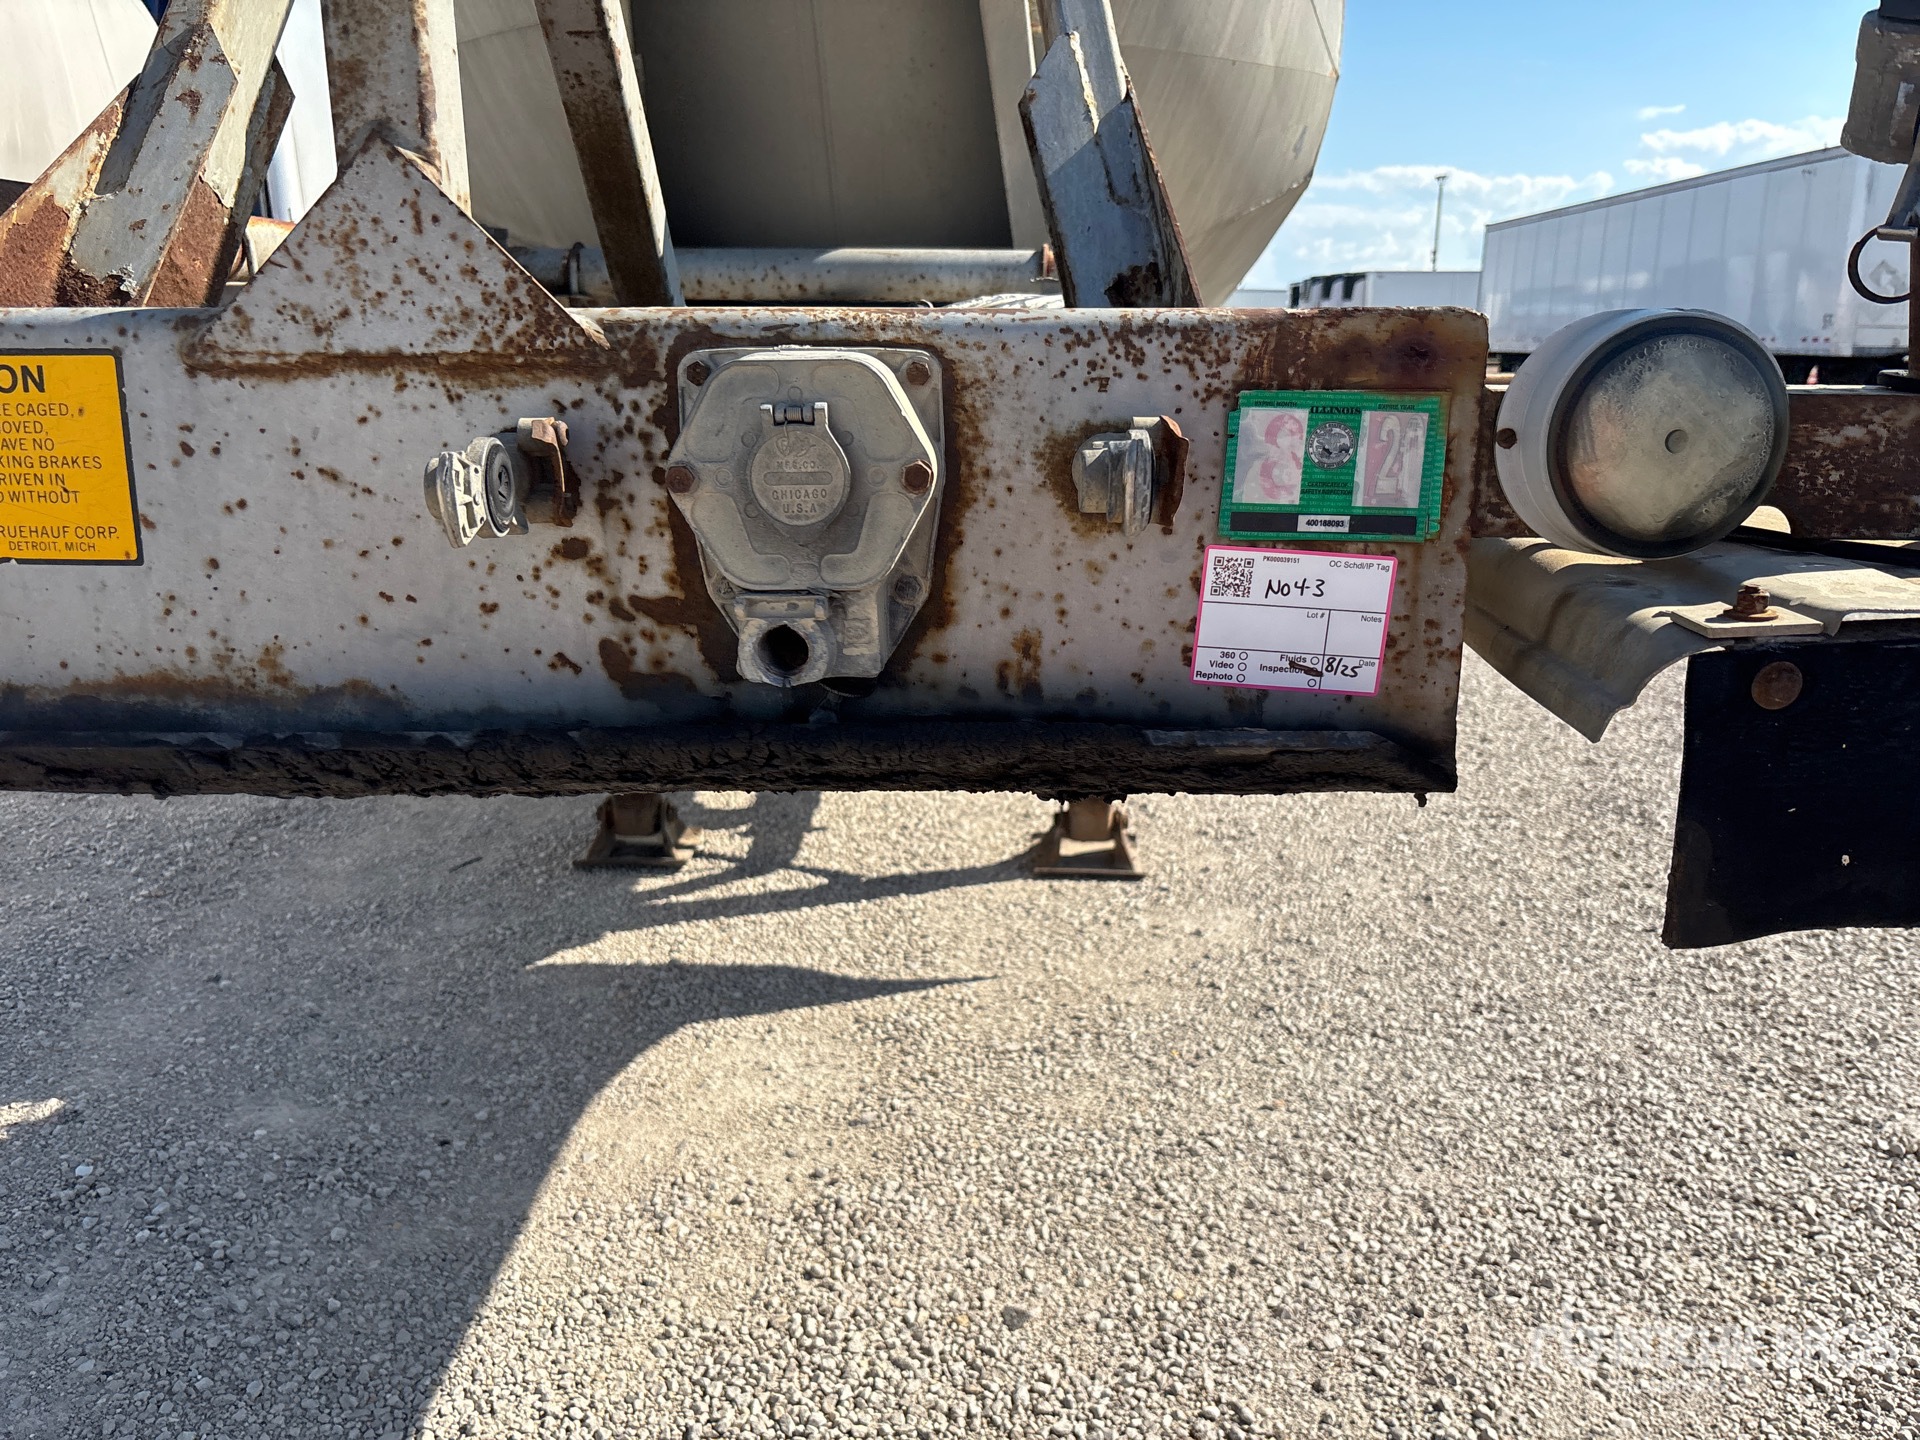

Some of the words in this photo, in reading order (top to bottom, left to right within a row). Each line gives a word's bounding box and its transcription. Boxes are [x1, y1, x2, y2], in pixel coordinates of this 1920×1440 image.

[15, 402, 75, 418] CAGED,
[1310, 405, 1361, 415] ILLINOIS
[0, 437, 28, 451] AVE
[32, 438, 55, 452] NO
[38, 455, 103, 470] BRAKES
[49, 473, 65, 486] IN
[8, 490, 80, 504] WITHOUT
[771, 488, 828, 501] CHICAGO
[1305, 519, 1345, 528] 400188093
[74, 526, 120, 540] CORP.
[8, 541, 62, 553] DETROIT,
[1329, 560, 1343, 568] OC
[1376, 563, 1391, 573] Tag
[1306, 611, 1319, 619] Lot
[1360, 615, 1383, 624] Notes
[1219, 651, 1236, 660] 360
[1279, 654, 1308, 664] Fluids
[1209, 660, 1235, 669] Video
[1358, 659, 1376, 668] Date
[1195, 670, 1233, 682] Rephoto
